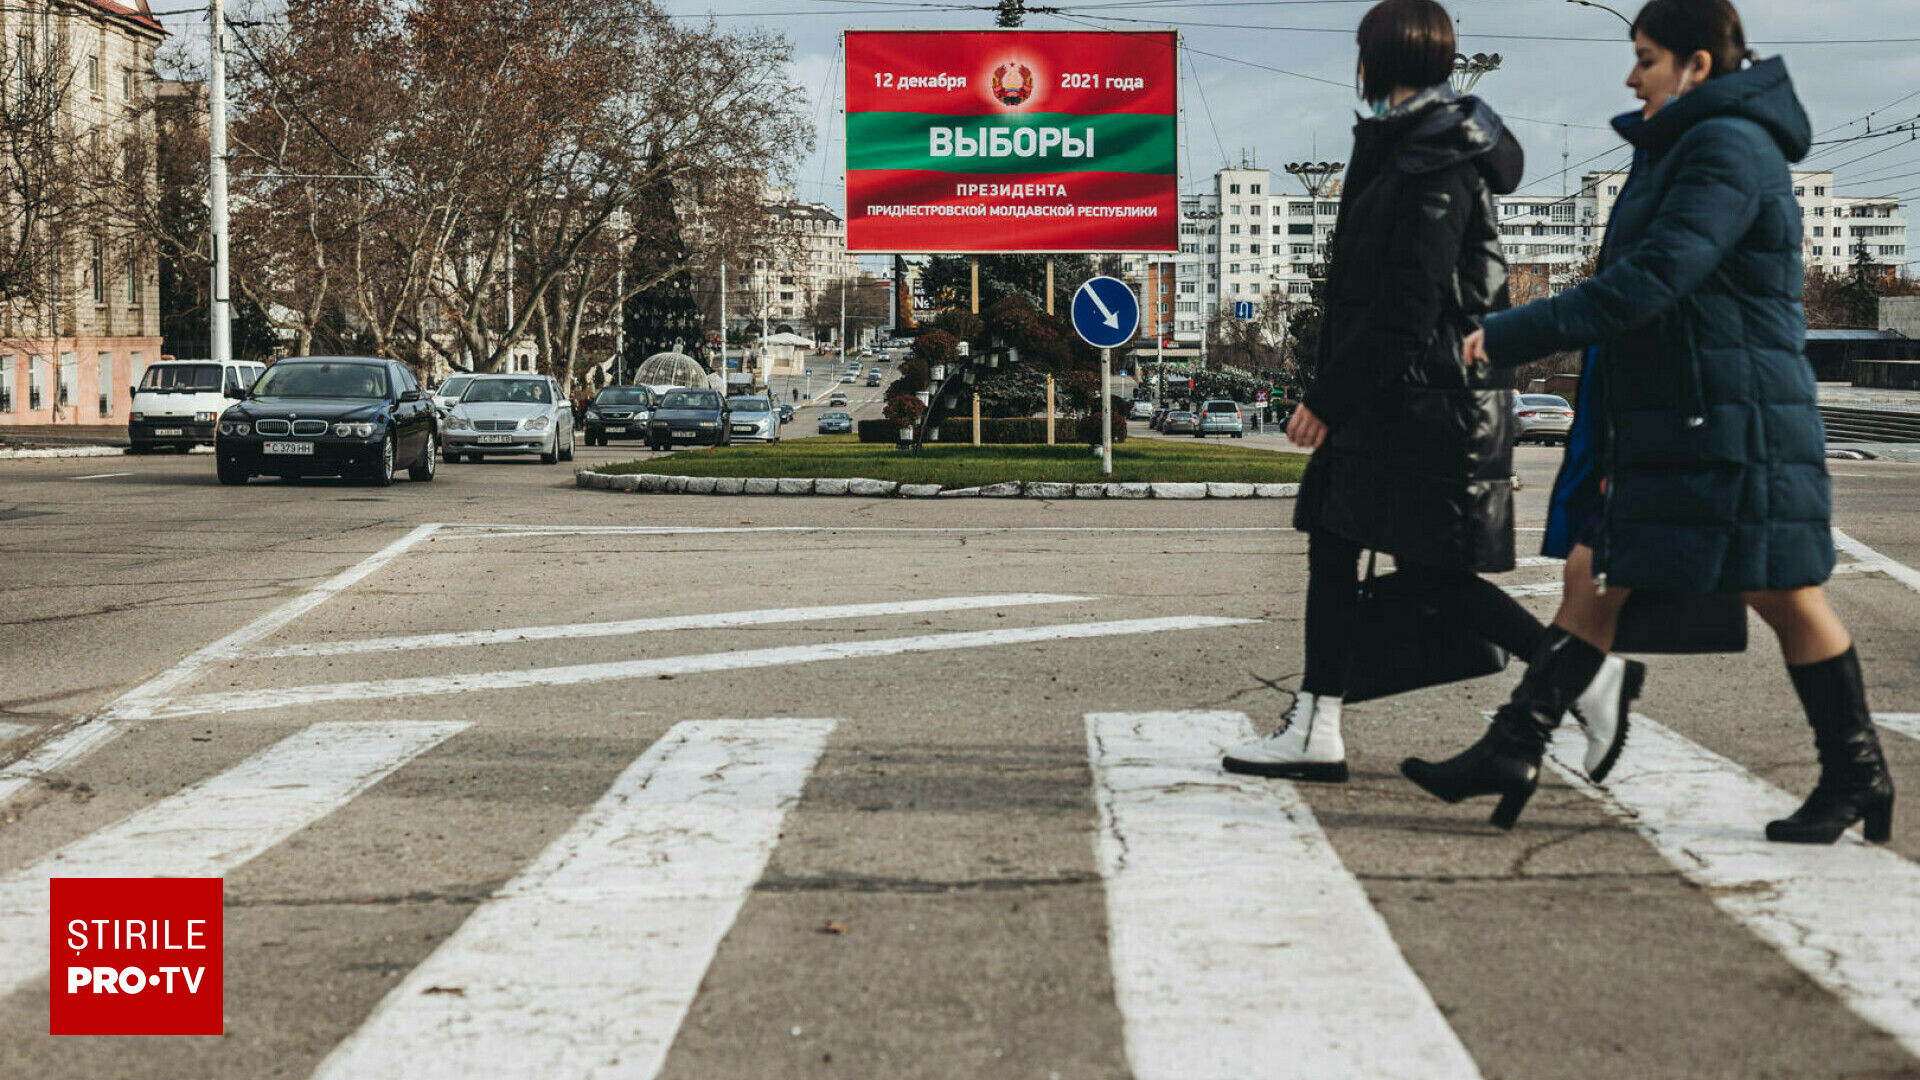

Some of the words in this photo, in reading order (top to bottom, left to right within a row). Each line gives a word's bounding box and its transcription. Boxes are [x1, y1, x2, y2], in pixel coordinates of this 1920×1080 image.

[874, 72, 893, 88] 12
[897, 72, 967, 92] декабря
[1061, 73, 1099, 88] 2021
[1105, 77, 1144, 91] года
[929, 126, 1095, 158] ВЫБОРЫ
[956, 183, 1067, 198] ПРЕЗИДЕНТА
[867, 203, 987, 218] ПРИДНЕСТРОВСКОЙ
[989, 203, 1075, 219] МОЛДАВСКОЙ
[1077, 206, 1158, 219] РЕСПУБЛИКИ
